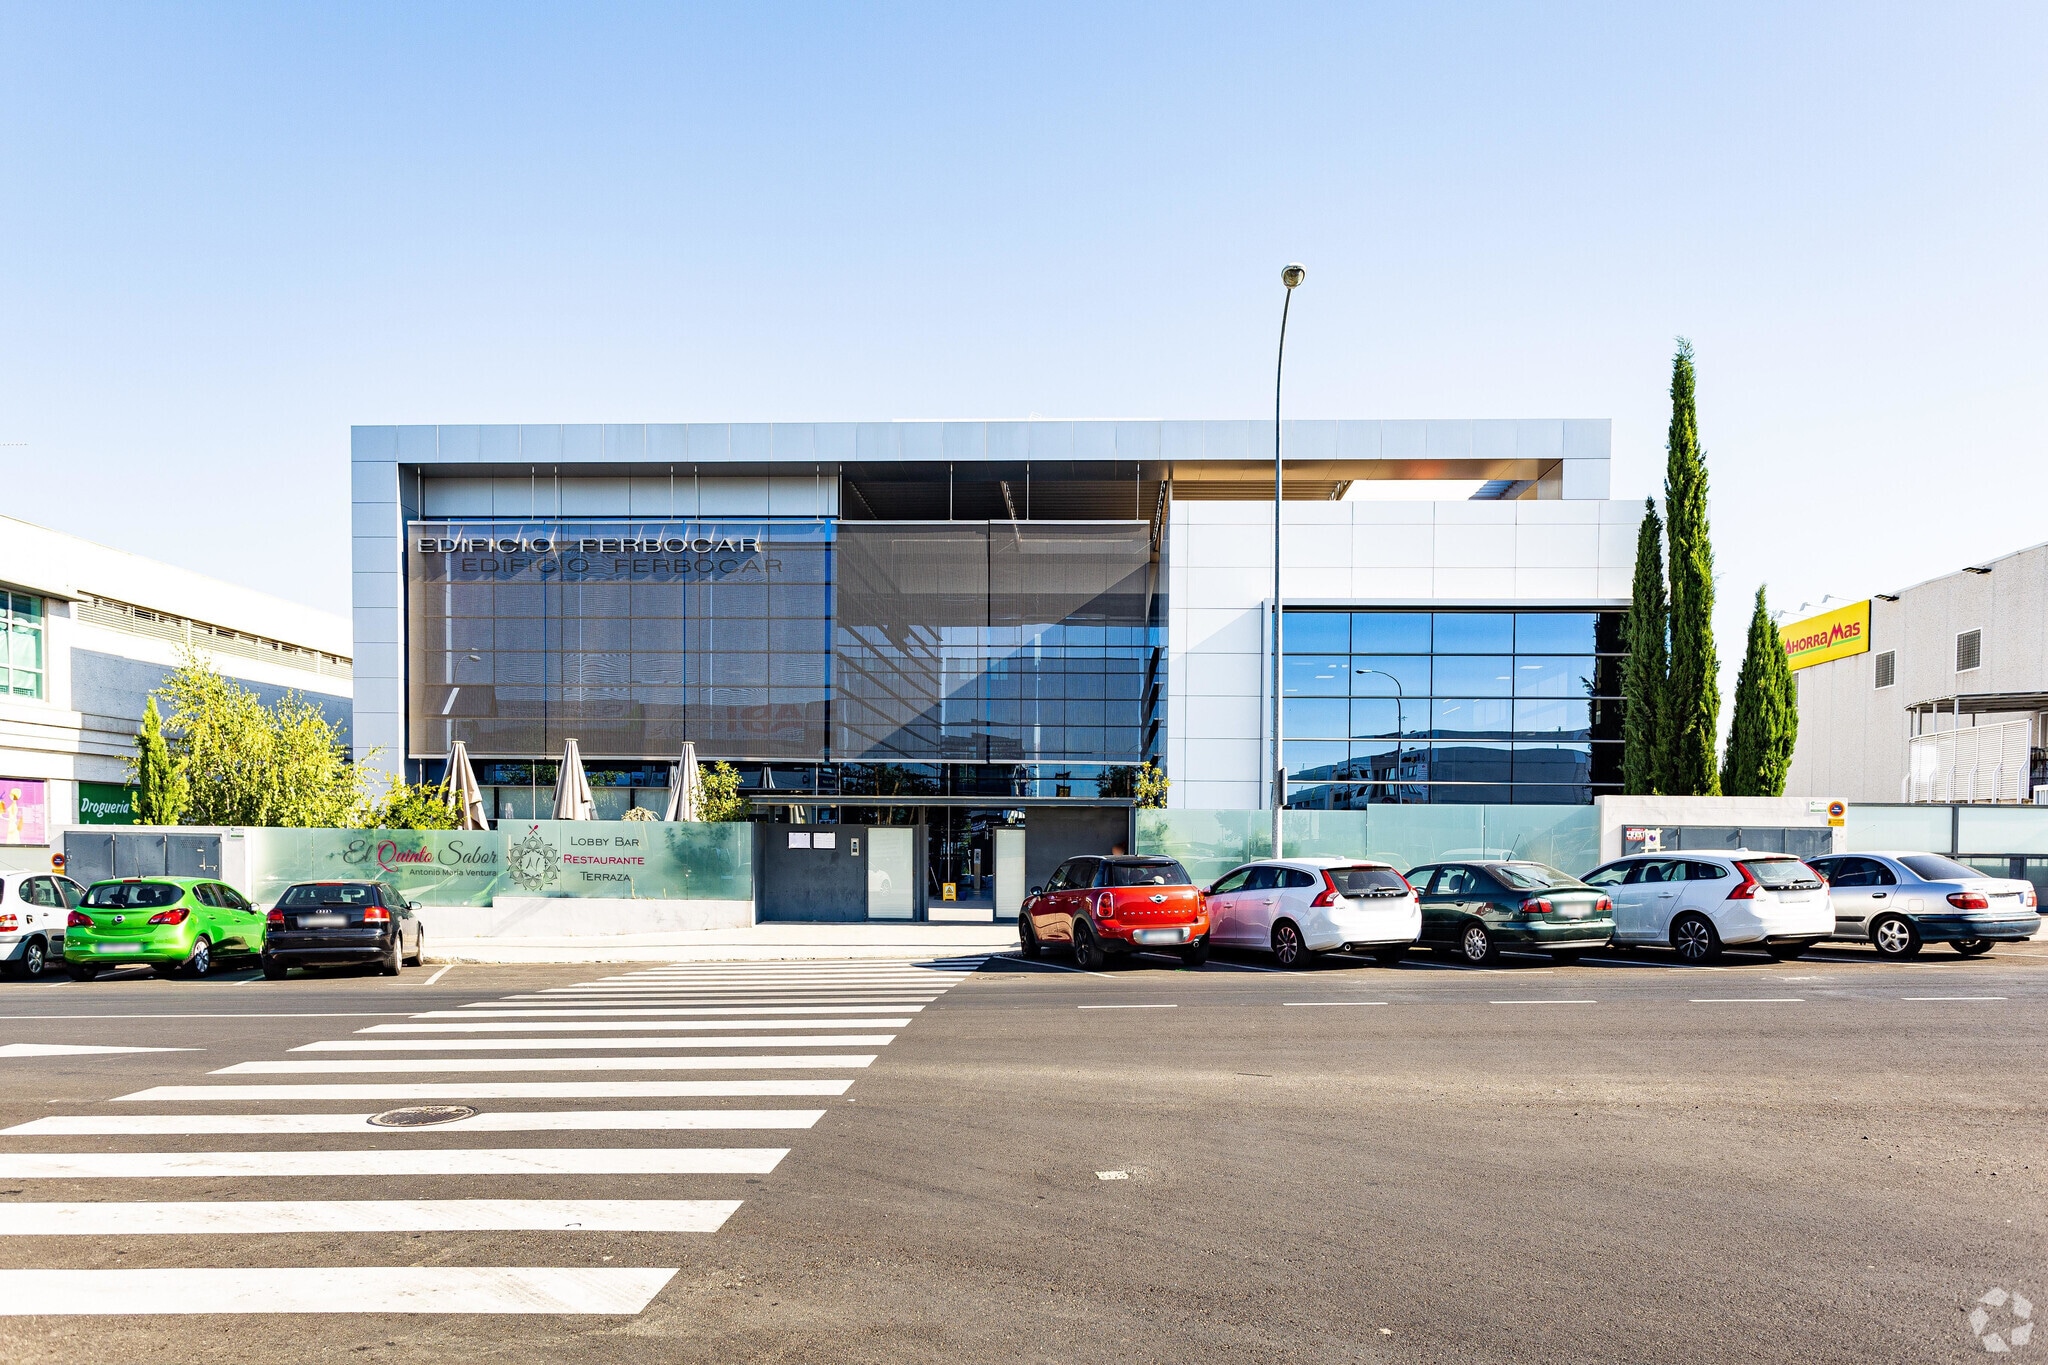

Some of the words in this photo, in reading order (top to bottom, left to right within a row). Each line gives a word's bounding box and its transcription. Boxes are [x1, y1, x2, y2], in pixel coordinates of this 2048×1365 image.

[417, 537, 554, 553] EDIFICIO
[579, 537, 761, 553] FERBOCAR
[342, 839, 374, 864] El
[376, 839, 434, 873] Quinto
[437, 840, 498, 866] Sabor
[409, 868, 440, 876] Antonio
[465, 869, 497, 877] Ventura
